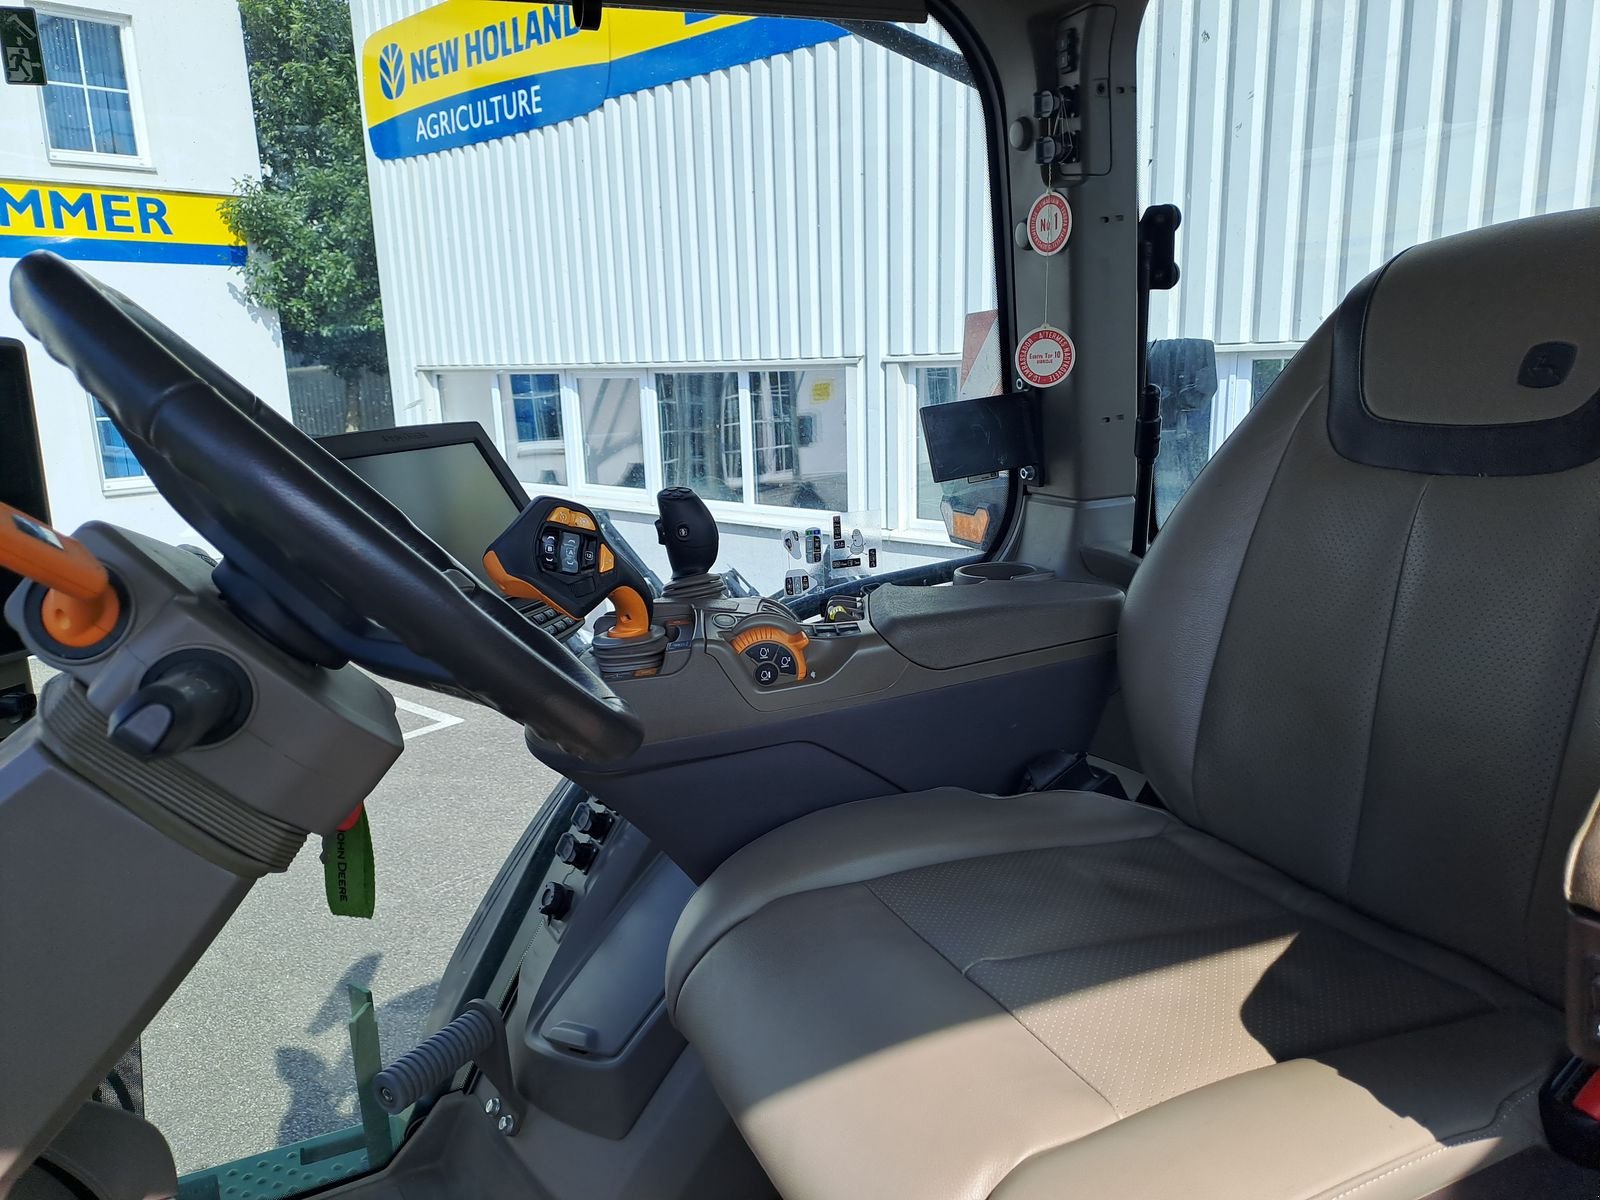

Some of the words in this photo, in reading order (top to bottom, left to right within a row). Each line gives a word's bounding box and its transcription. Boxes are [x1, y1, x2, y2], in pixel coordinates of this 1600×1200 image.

[410, 37, 459, 84] NEW
[416, 85, 543, 142] AGRICULTURE
[336, 831, 345, 859] OHN
[338, 862, 348, 902] DEERE
